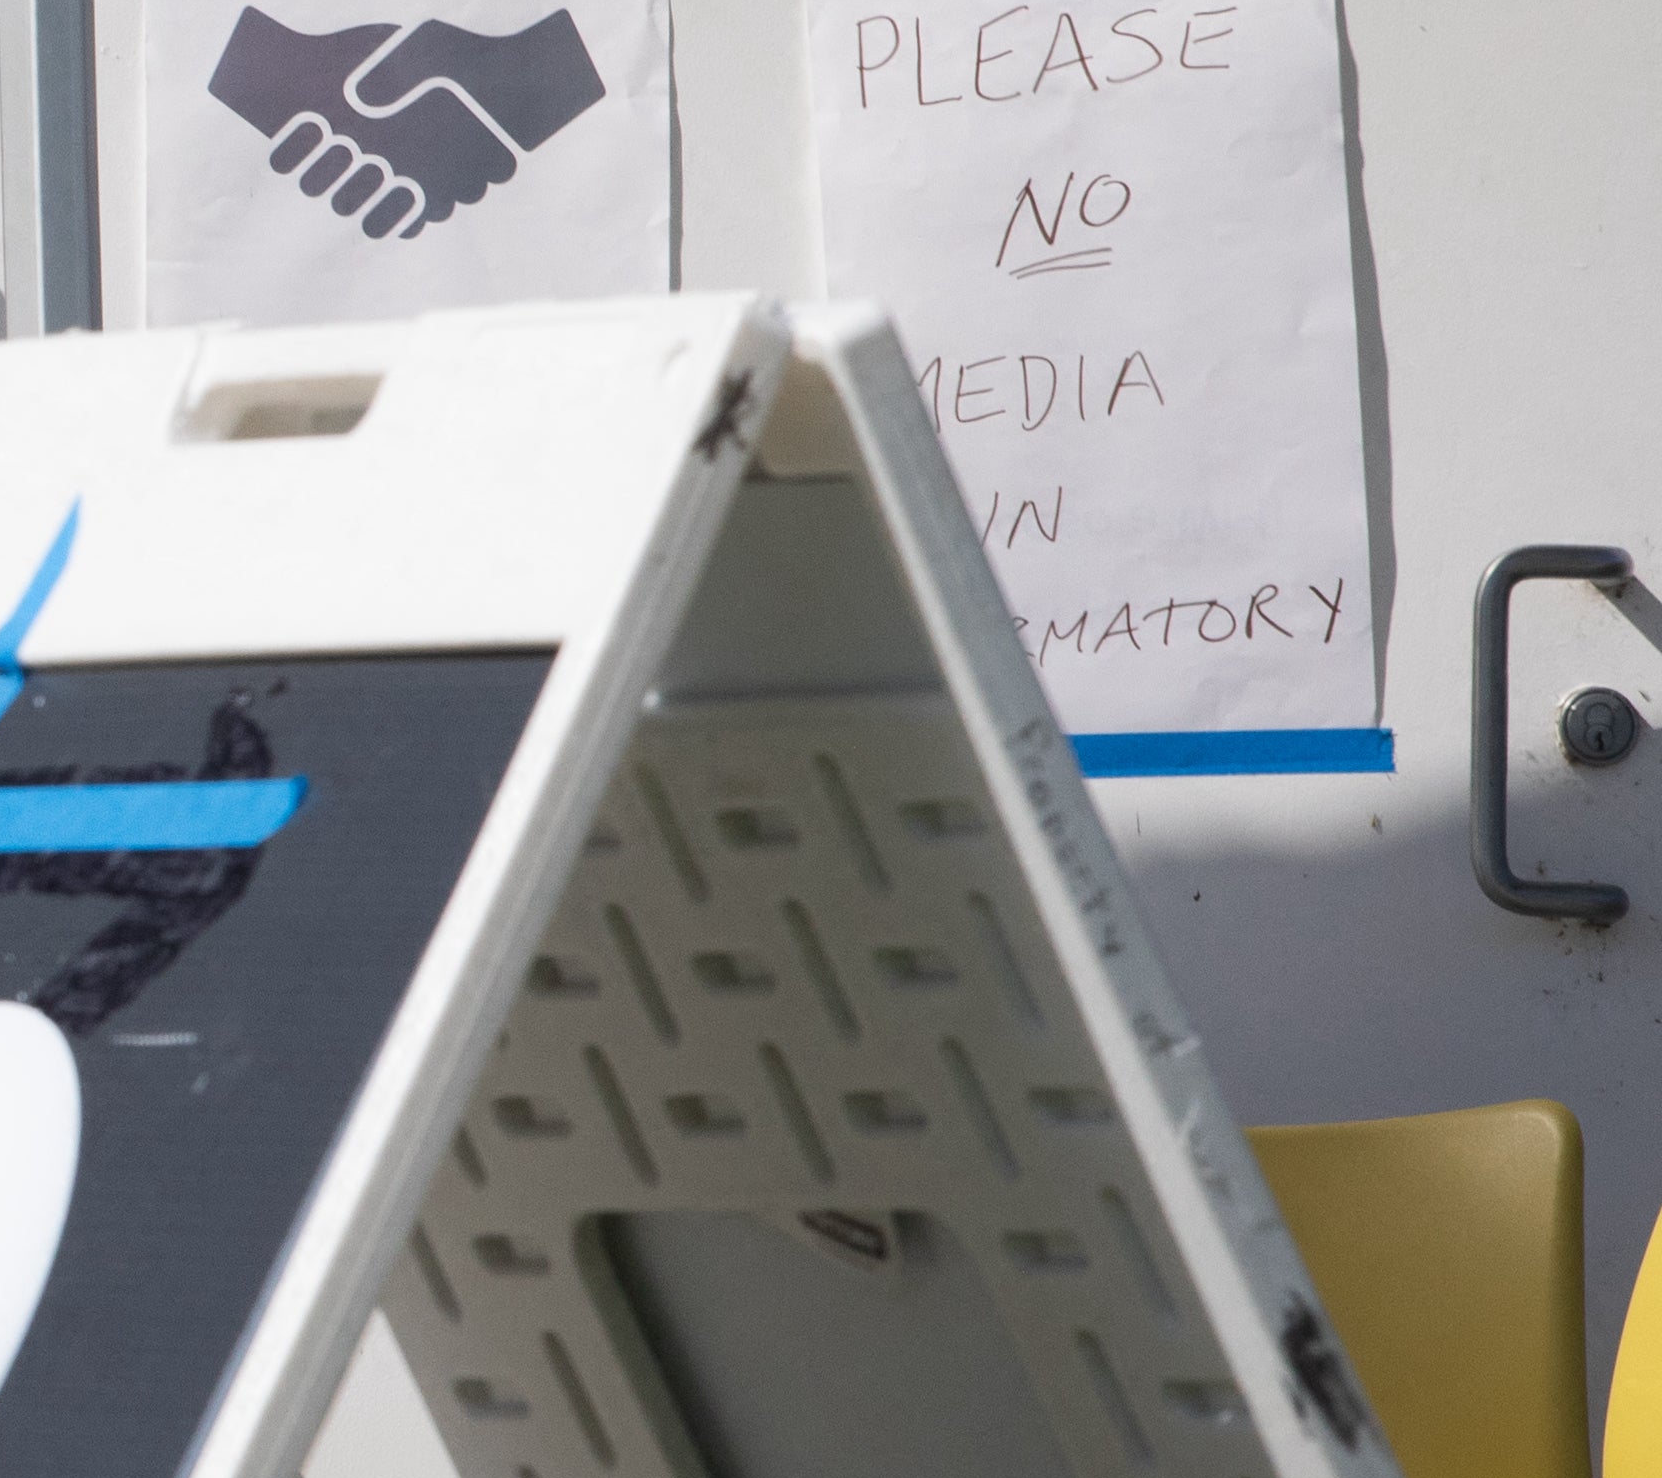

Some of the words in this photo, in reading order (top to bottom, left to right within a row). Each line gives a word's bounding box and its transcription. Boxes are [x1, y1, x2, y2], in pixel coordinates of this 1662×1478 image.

[855, 4, 1239, 109] PLEASE
[995, 173, 1132, 268] NO
[981, 486, 1062, 549] IN
